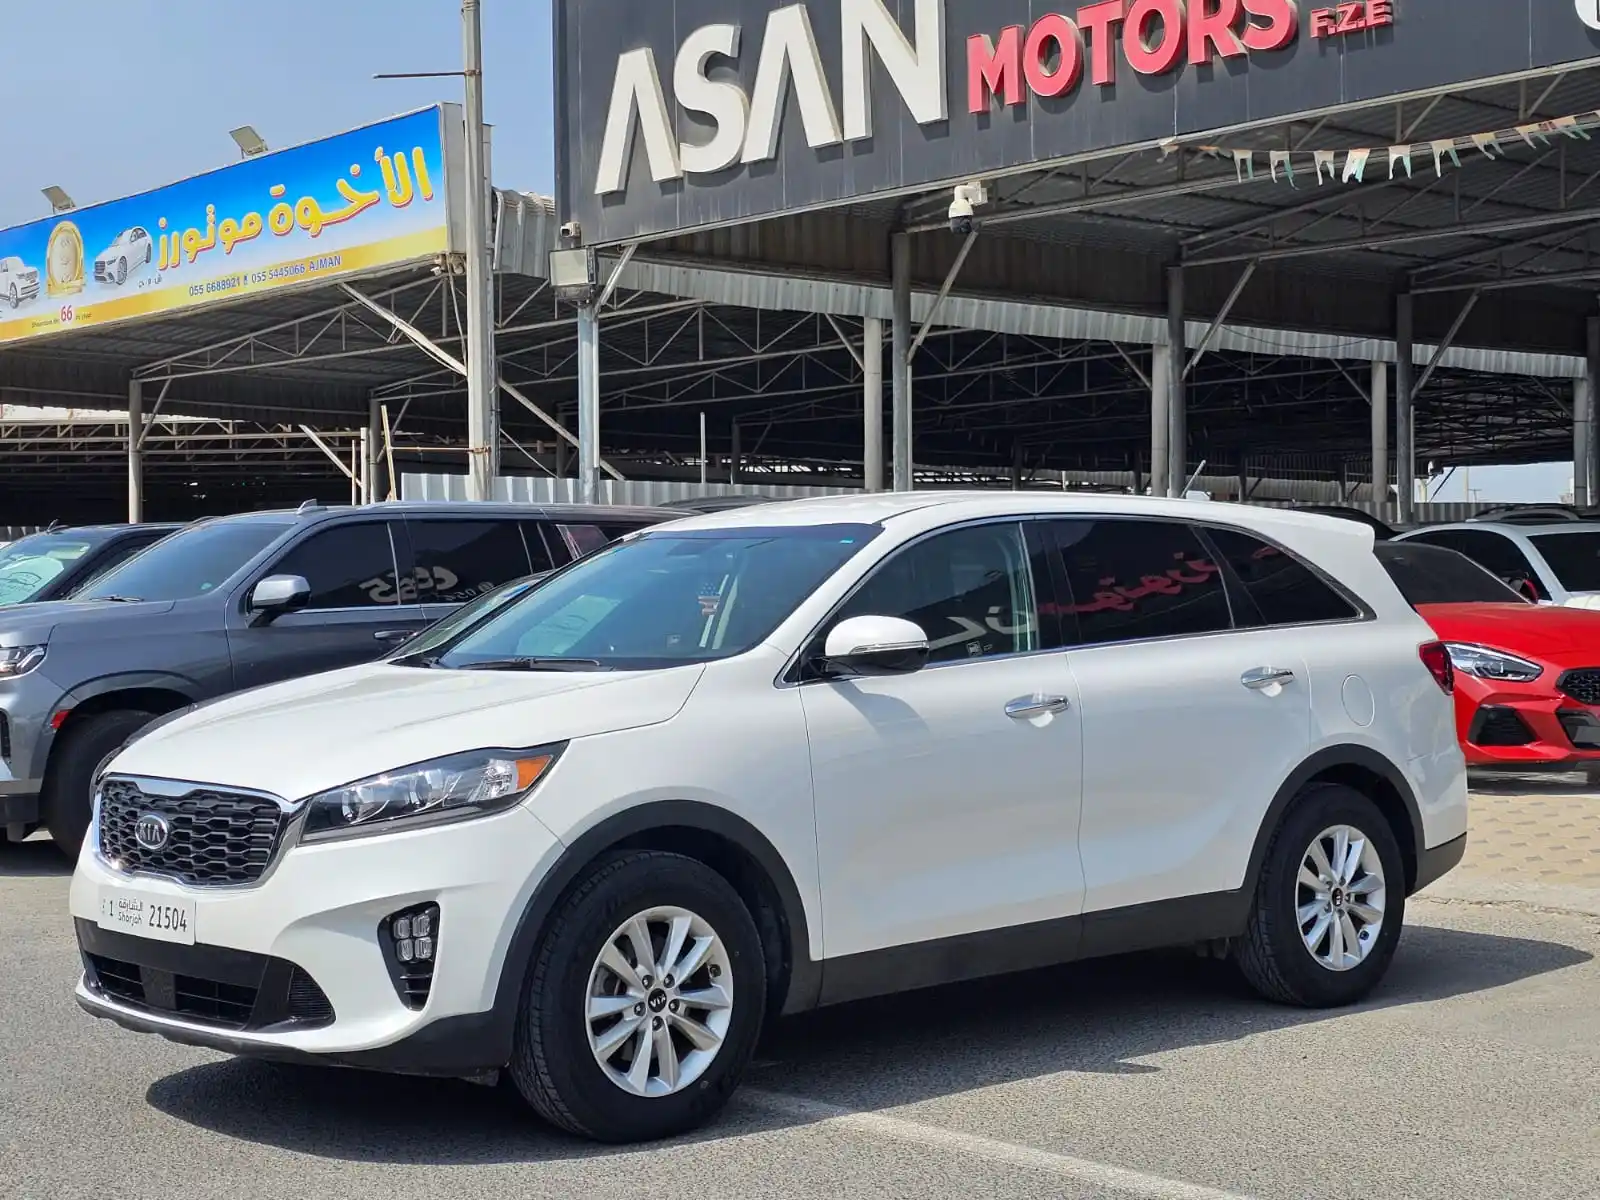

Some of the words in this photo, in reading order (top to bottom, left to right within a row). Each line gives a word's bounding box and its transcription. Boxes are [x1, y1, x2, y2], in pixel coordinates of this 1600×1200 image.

[594, 0, 948, 195] ASAN
[967, 0, 1297, 114] MOTORS
[1310, 0, 1393, 38] F.Z.E
[268, 146, 434, 238] الأخوة
[157, 203, 262, 271] موتورز
[189, 286, 204, 296] 055
[251, 272, 267, 283] 055
[309, 255, 341, 271] AJMAN
[60, 305, 73, 322] 66
[139, 822, 161, 842] KIA
[109, 900, 114, 917] 1
[148, 904, 187, 933] 21504
